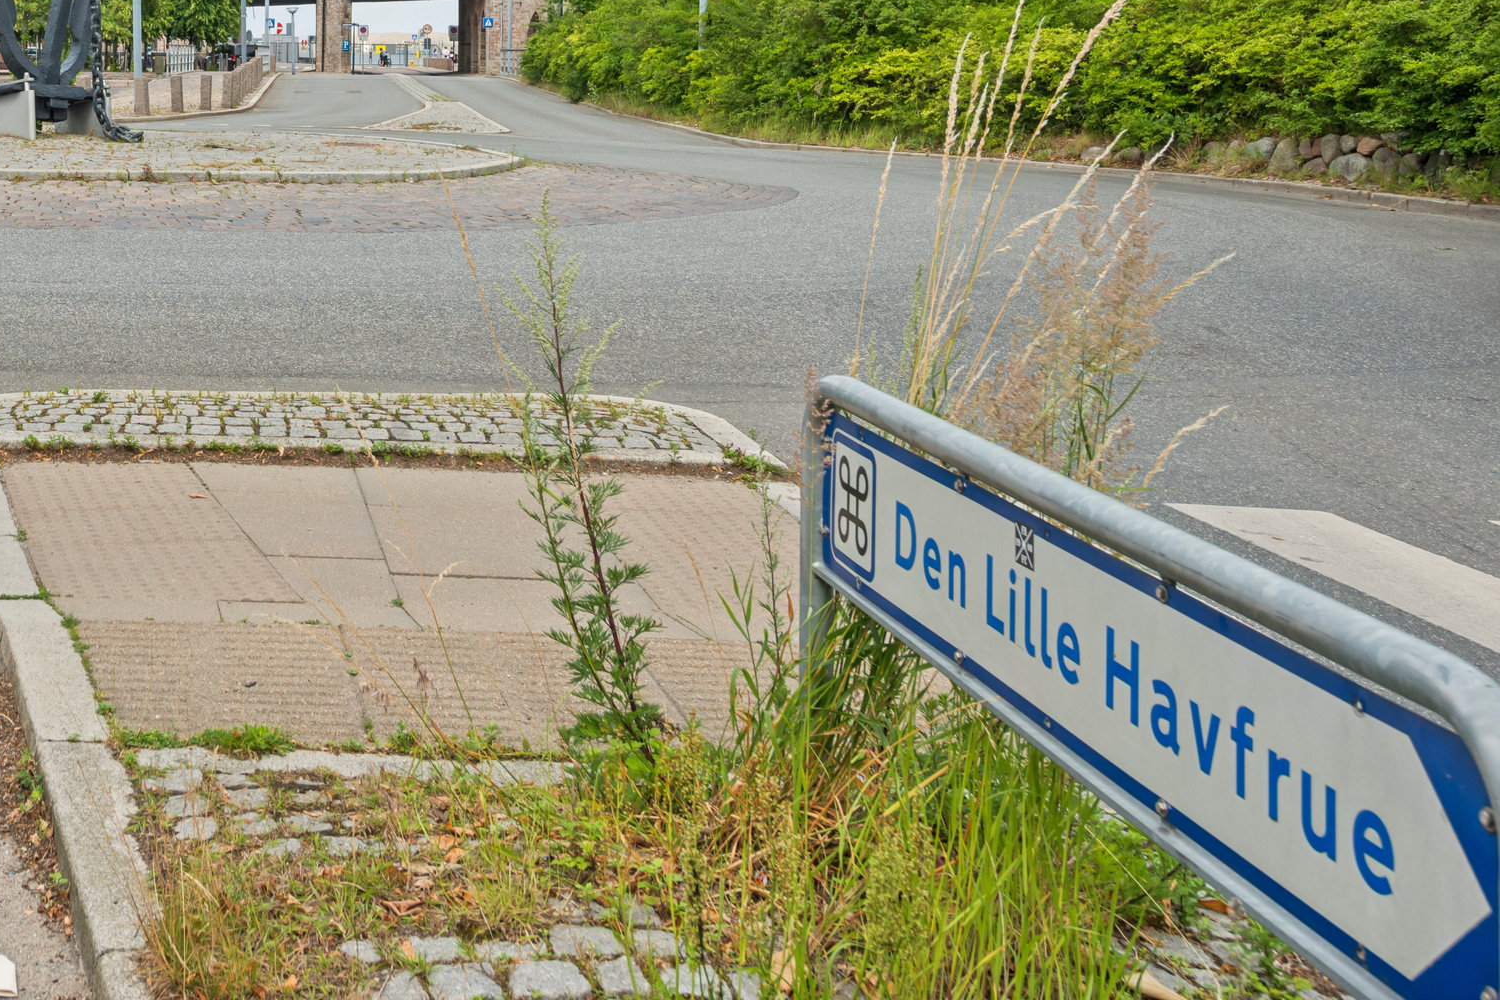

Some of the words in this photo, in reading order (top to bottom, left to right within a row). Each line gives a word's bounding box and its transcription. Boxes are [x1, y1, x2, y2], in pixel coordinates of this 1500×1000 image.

[896, 500, 966, 609] Den
[986, 553, 1080, 685] Lille
[1106, 625, 1395, 896] Havfrue
